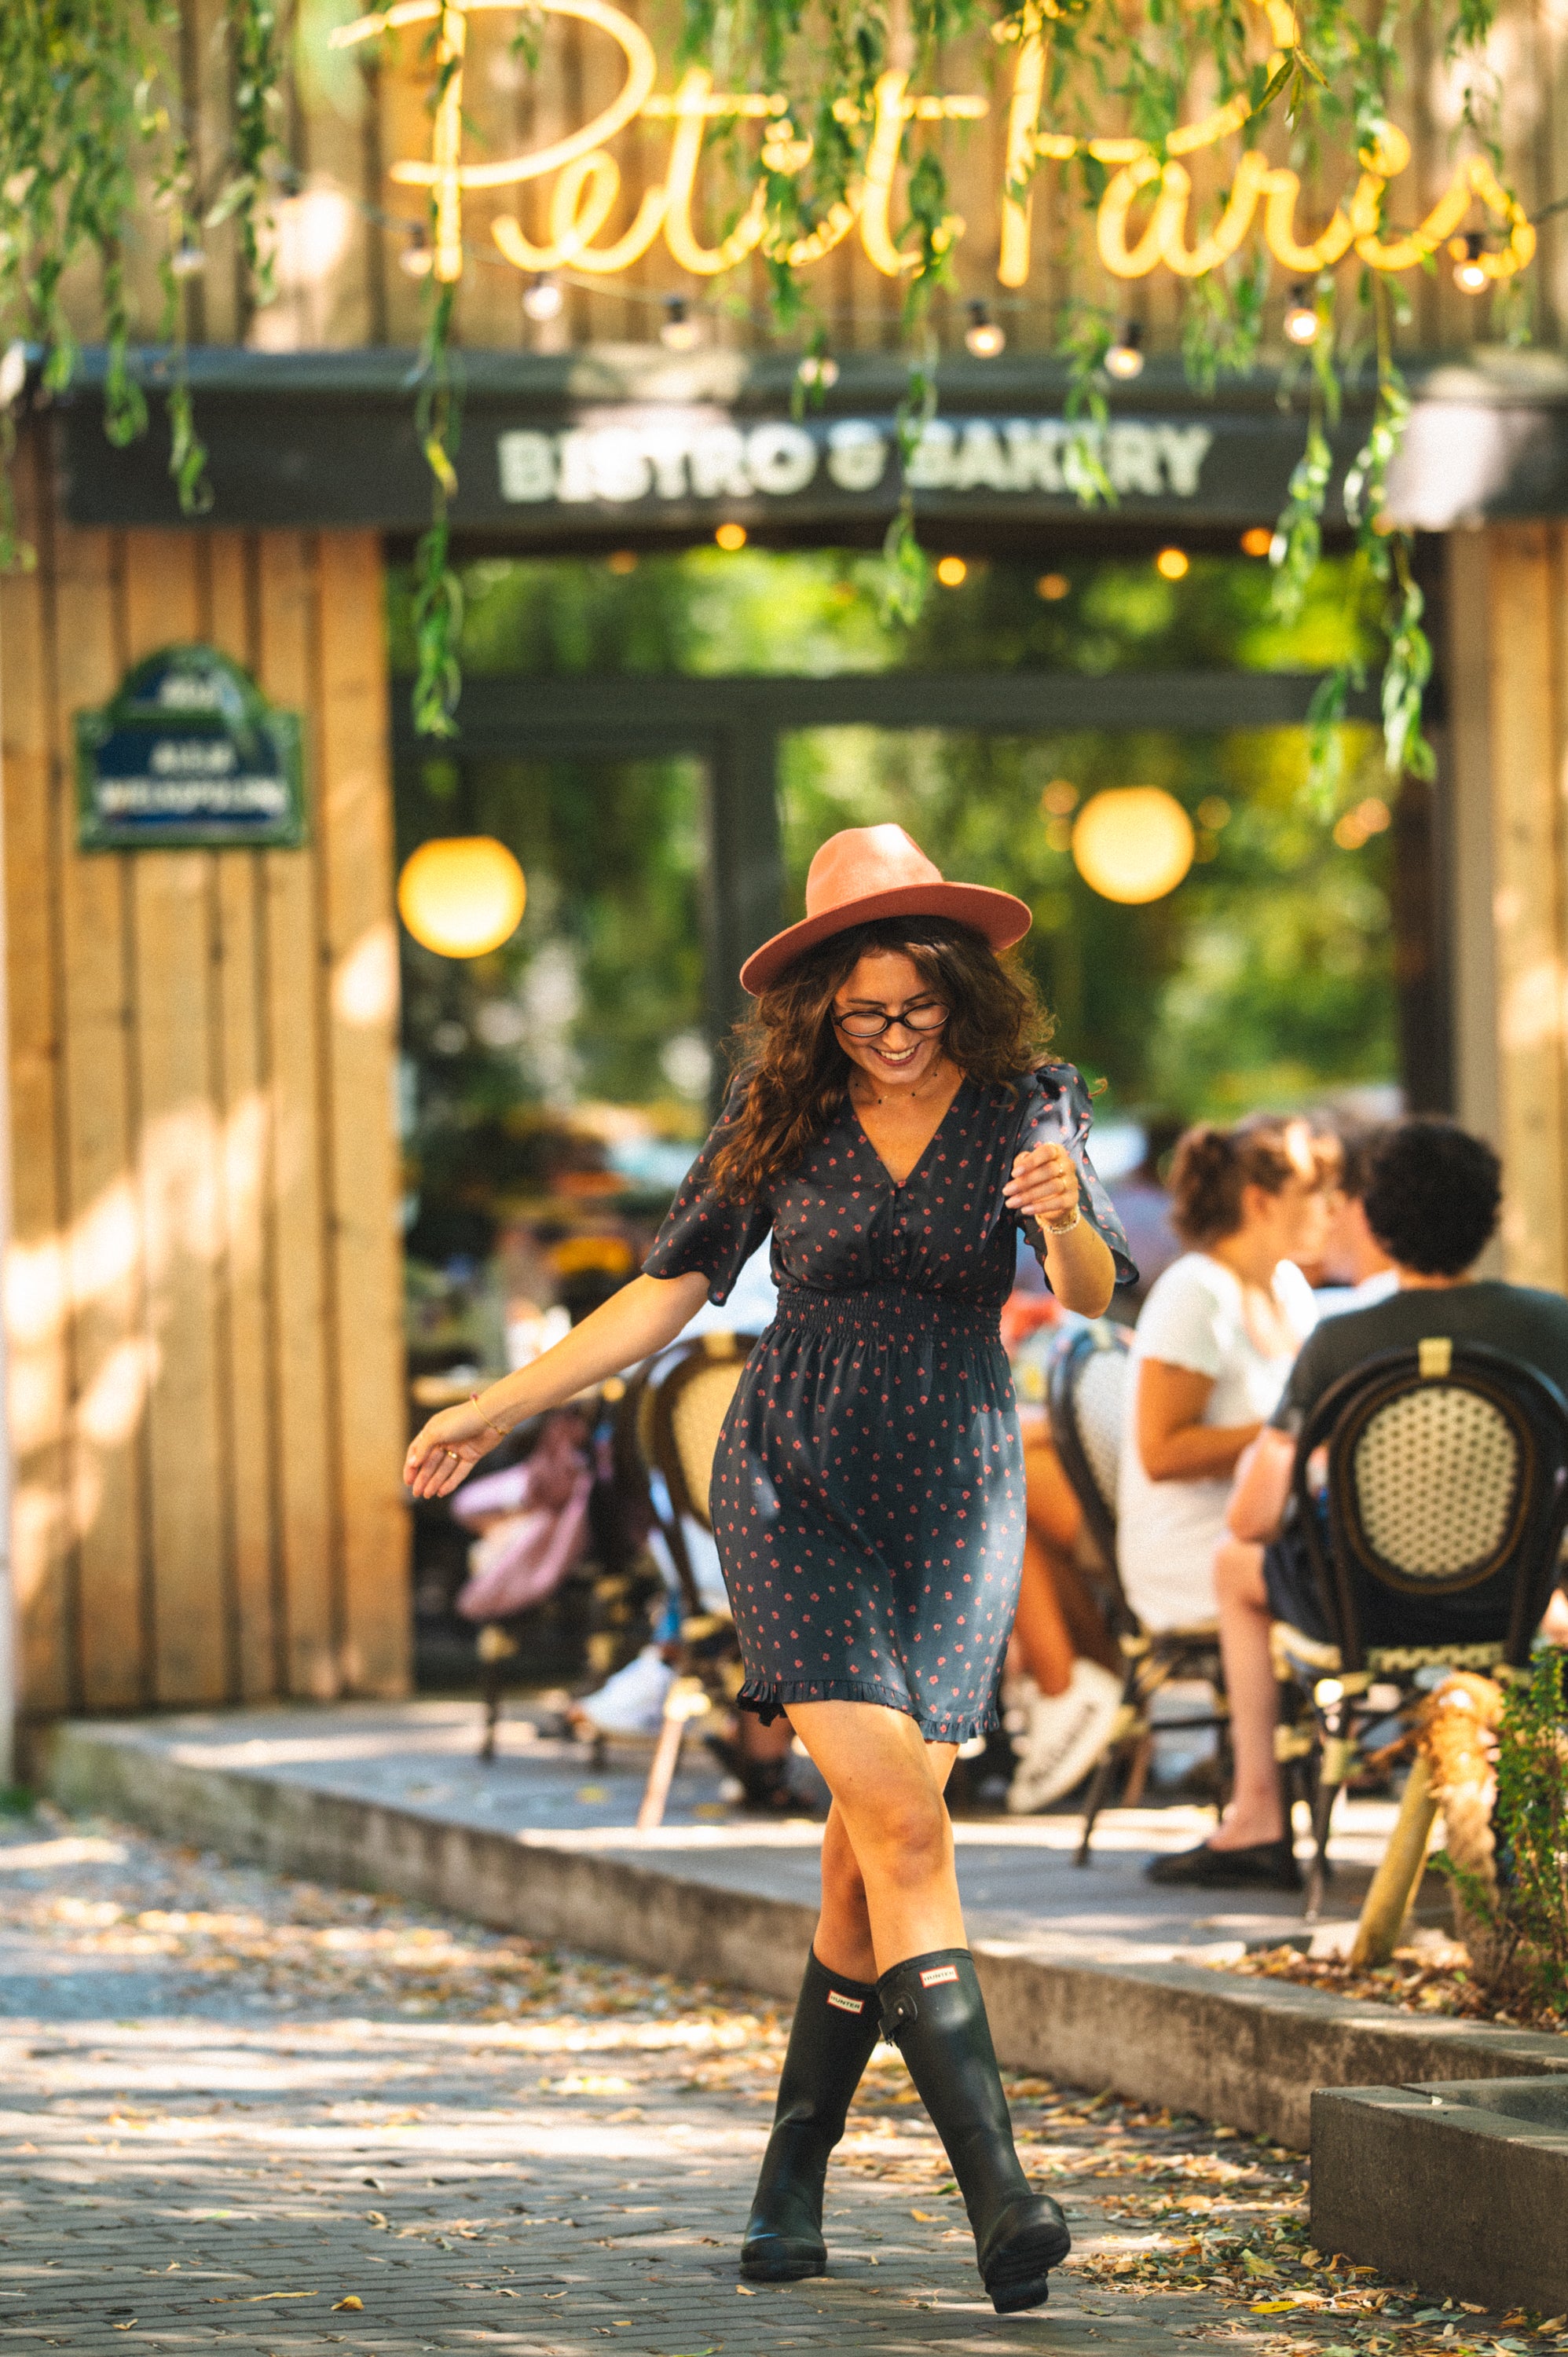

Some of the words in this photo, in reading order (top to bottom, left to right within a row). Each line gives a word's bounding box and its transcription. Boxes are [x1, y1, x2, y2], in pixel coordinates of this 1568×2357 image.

[327, 0, 990, 283] Petit
[496, 423, 818, 504] BISTRO
[830, 1995, 860, 2010] HUNTER
